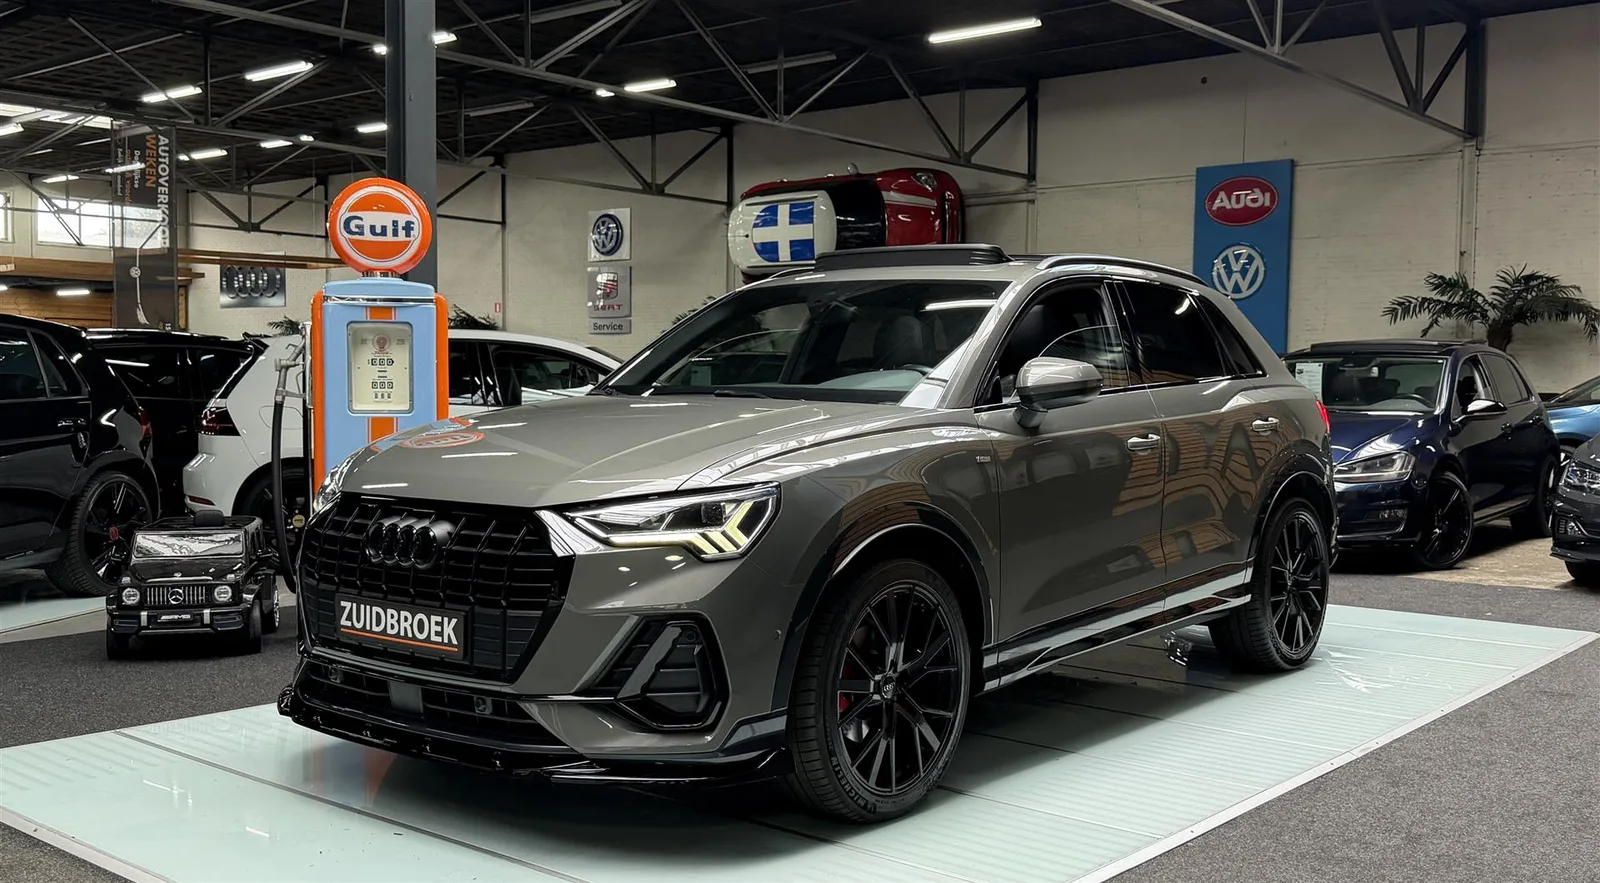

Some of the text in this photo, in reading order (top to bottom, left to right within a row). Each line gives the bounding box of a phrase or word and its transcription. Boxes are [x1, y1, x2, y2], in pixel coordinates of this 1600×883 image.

[132, 150, 141, 189] Daglijkse
[145, 134, 157, 188] WEKEN
[1212, 188, 1271, 210] Audi
[343, 215, 415, 238] Gulf
[593, 322, 623, 331] Service
[340, 601, 458, 645] ZUIDBROEK
